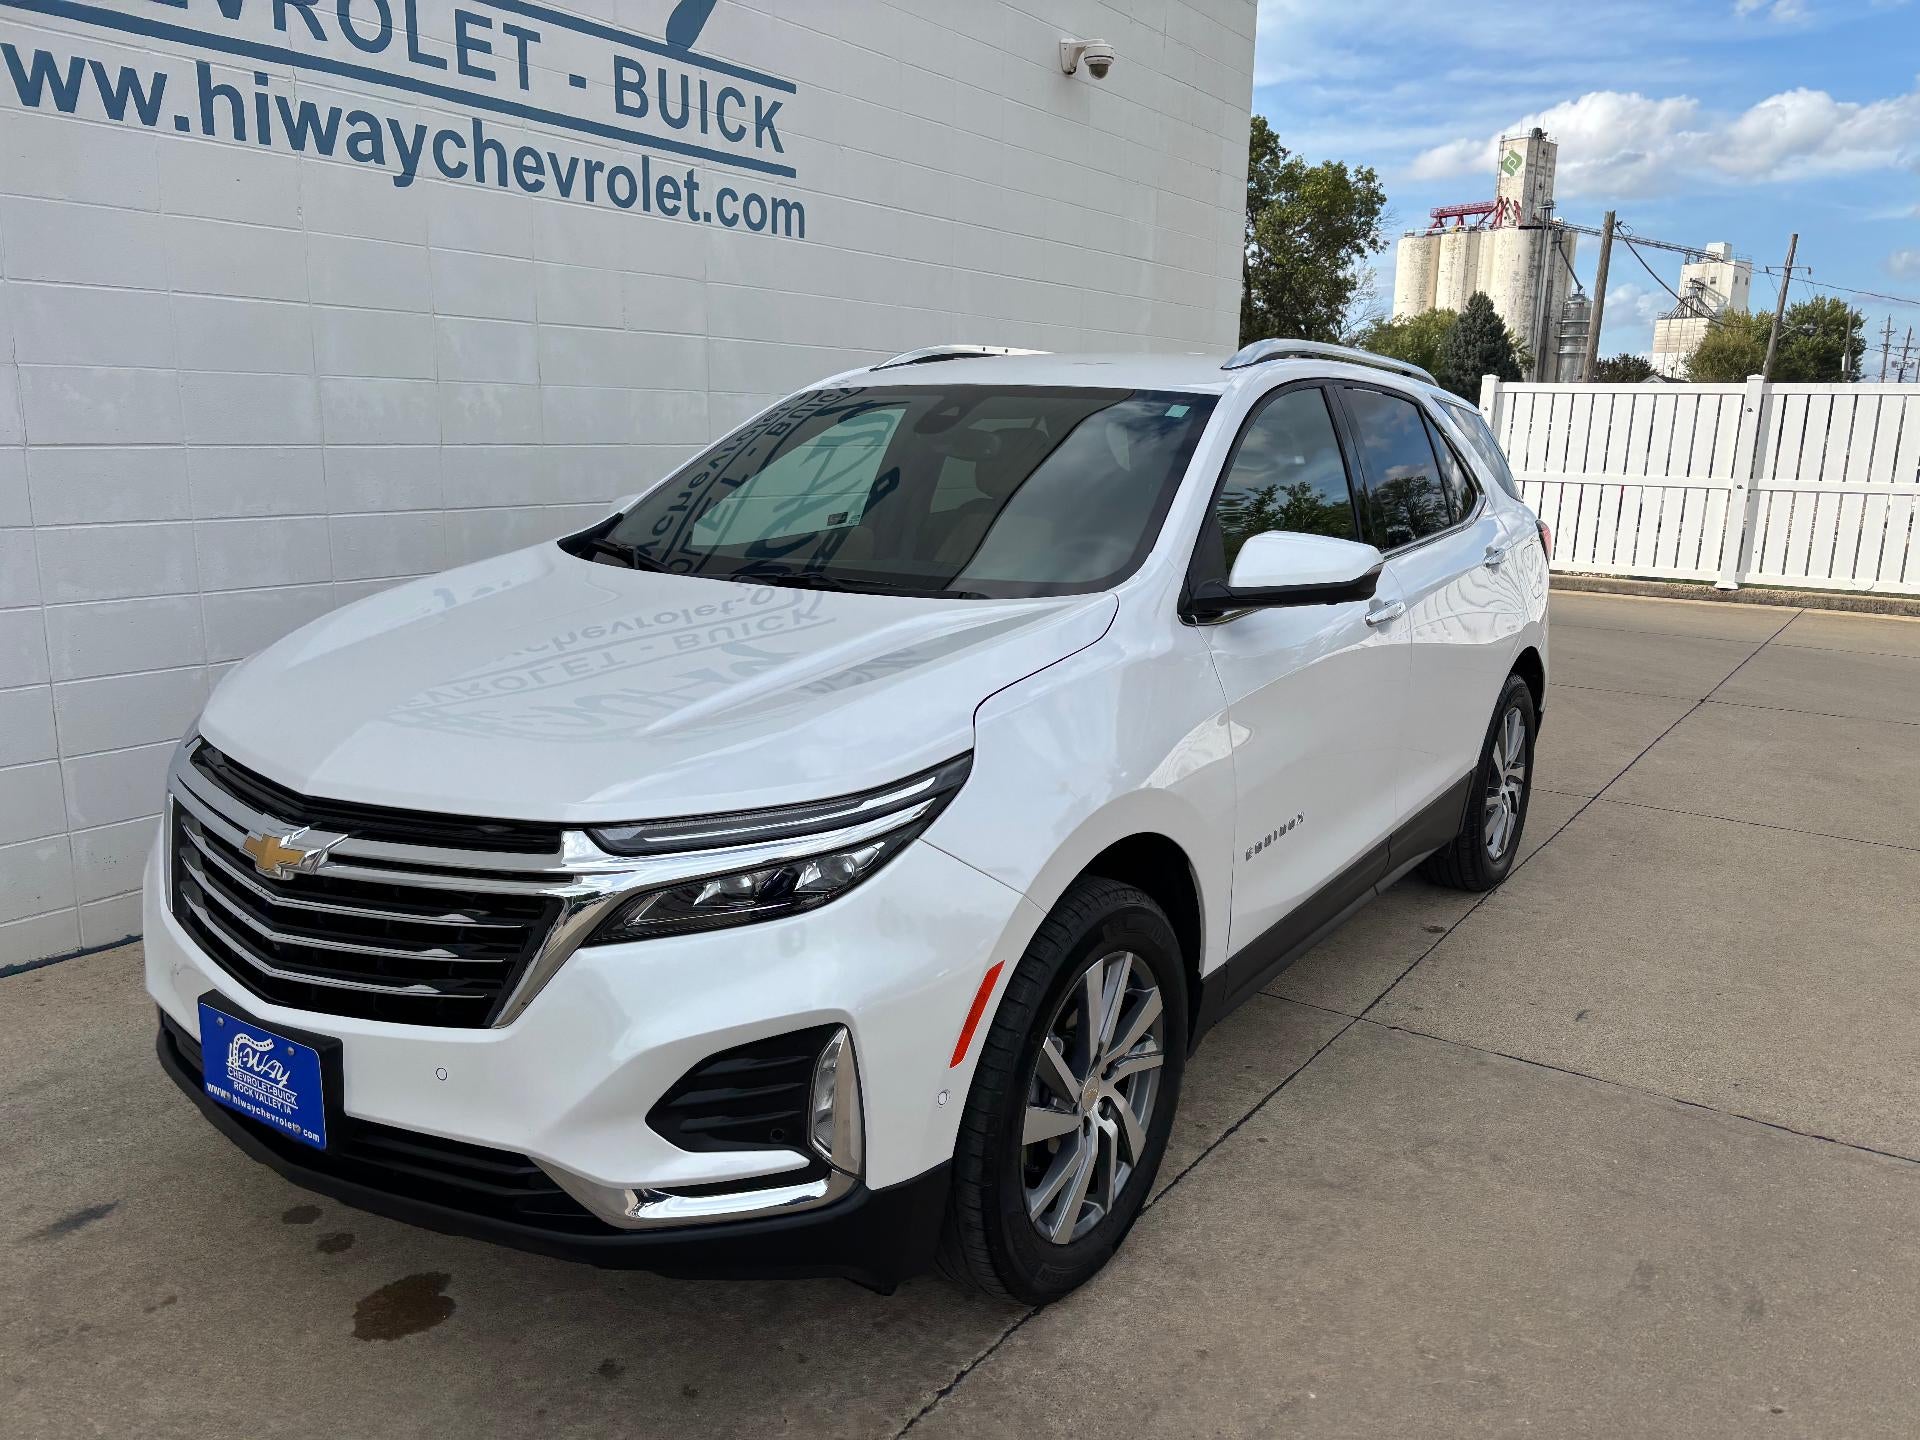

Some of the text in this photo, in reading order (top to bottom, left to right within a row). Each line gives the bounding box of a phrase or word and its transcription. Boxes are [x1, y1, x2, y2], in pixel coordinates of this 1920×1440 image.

[144, 0, 541, 90] ROLET
[614, 54, 784, 154] BUICK
[227, 1066, 297, 1106] CHEVROLET-BUICK
[233, 1081, 292, 1115] ROCK VALLEY, IA
